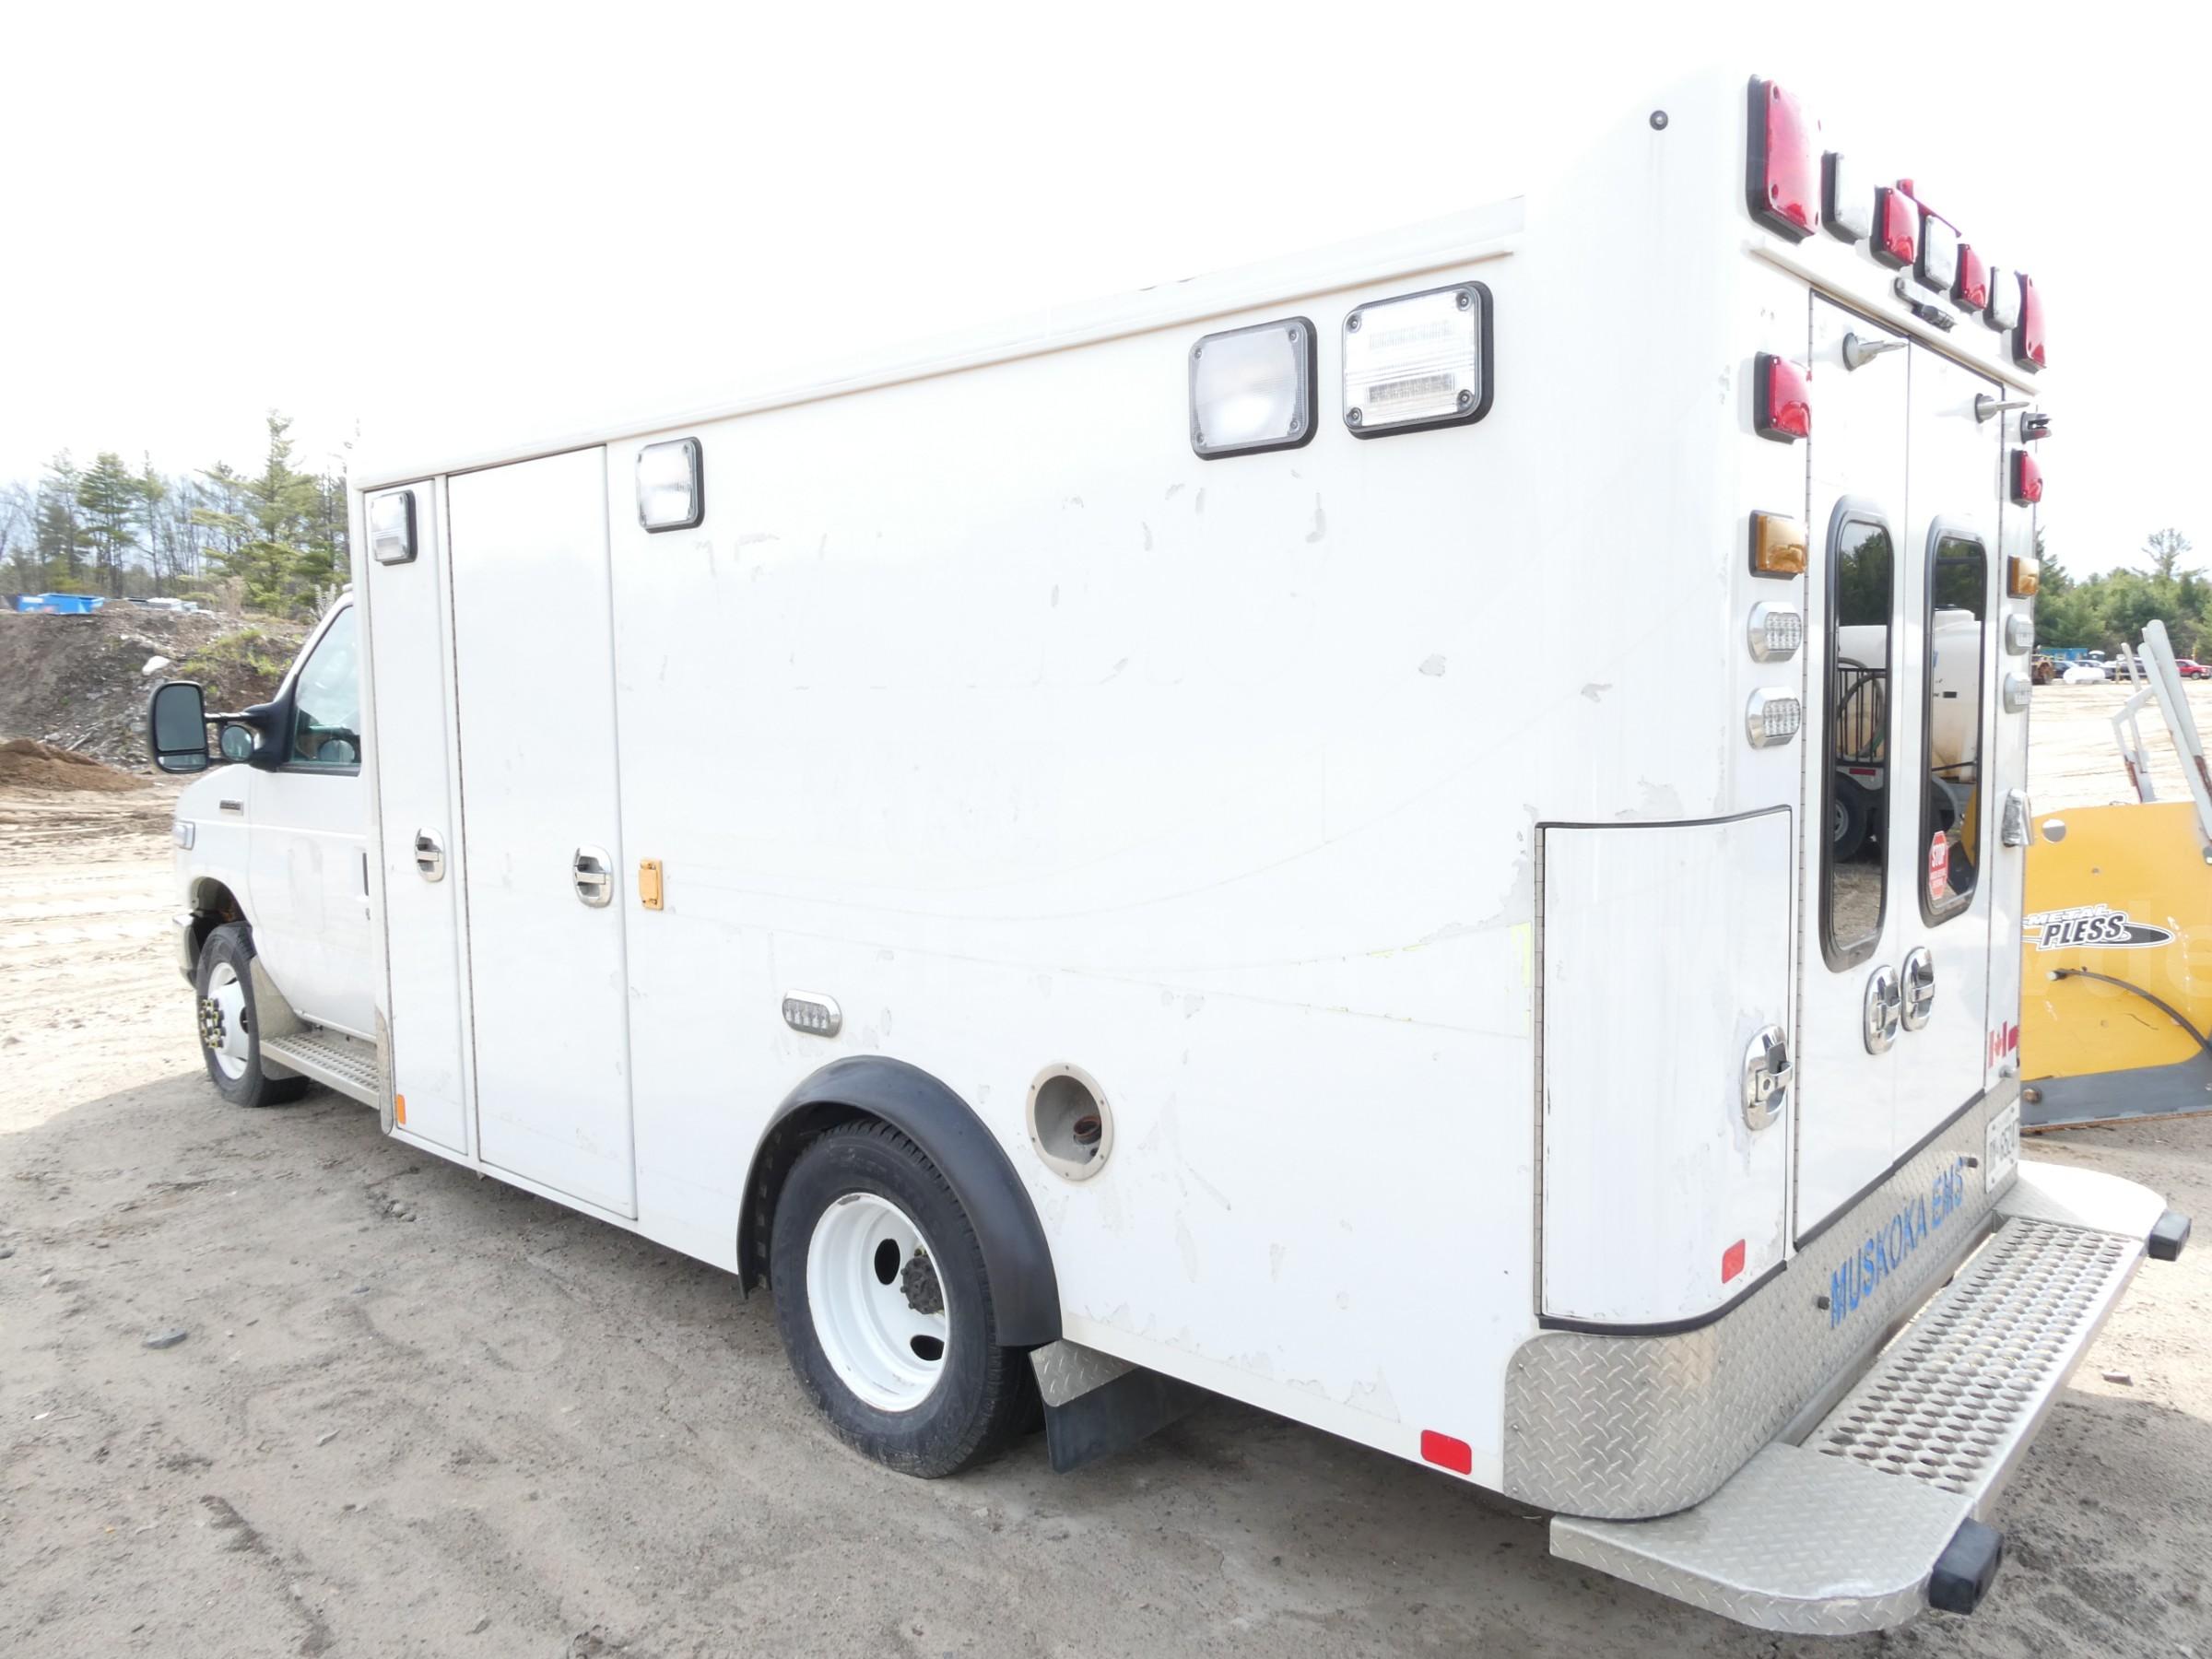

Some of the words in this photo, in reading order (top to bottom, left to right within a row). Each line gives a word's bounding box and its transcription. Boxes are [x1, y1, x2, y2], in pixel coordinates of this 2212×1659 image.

[1932, 842, 1946, 867] STOP
[2028, 904, 2112, 926] METAL
[2042, 914, 2124, 947] PLESS
[1830, 1194, 1928, 1328] MUSKOKA
[1932, 1157, 1964, 1229] EMS
